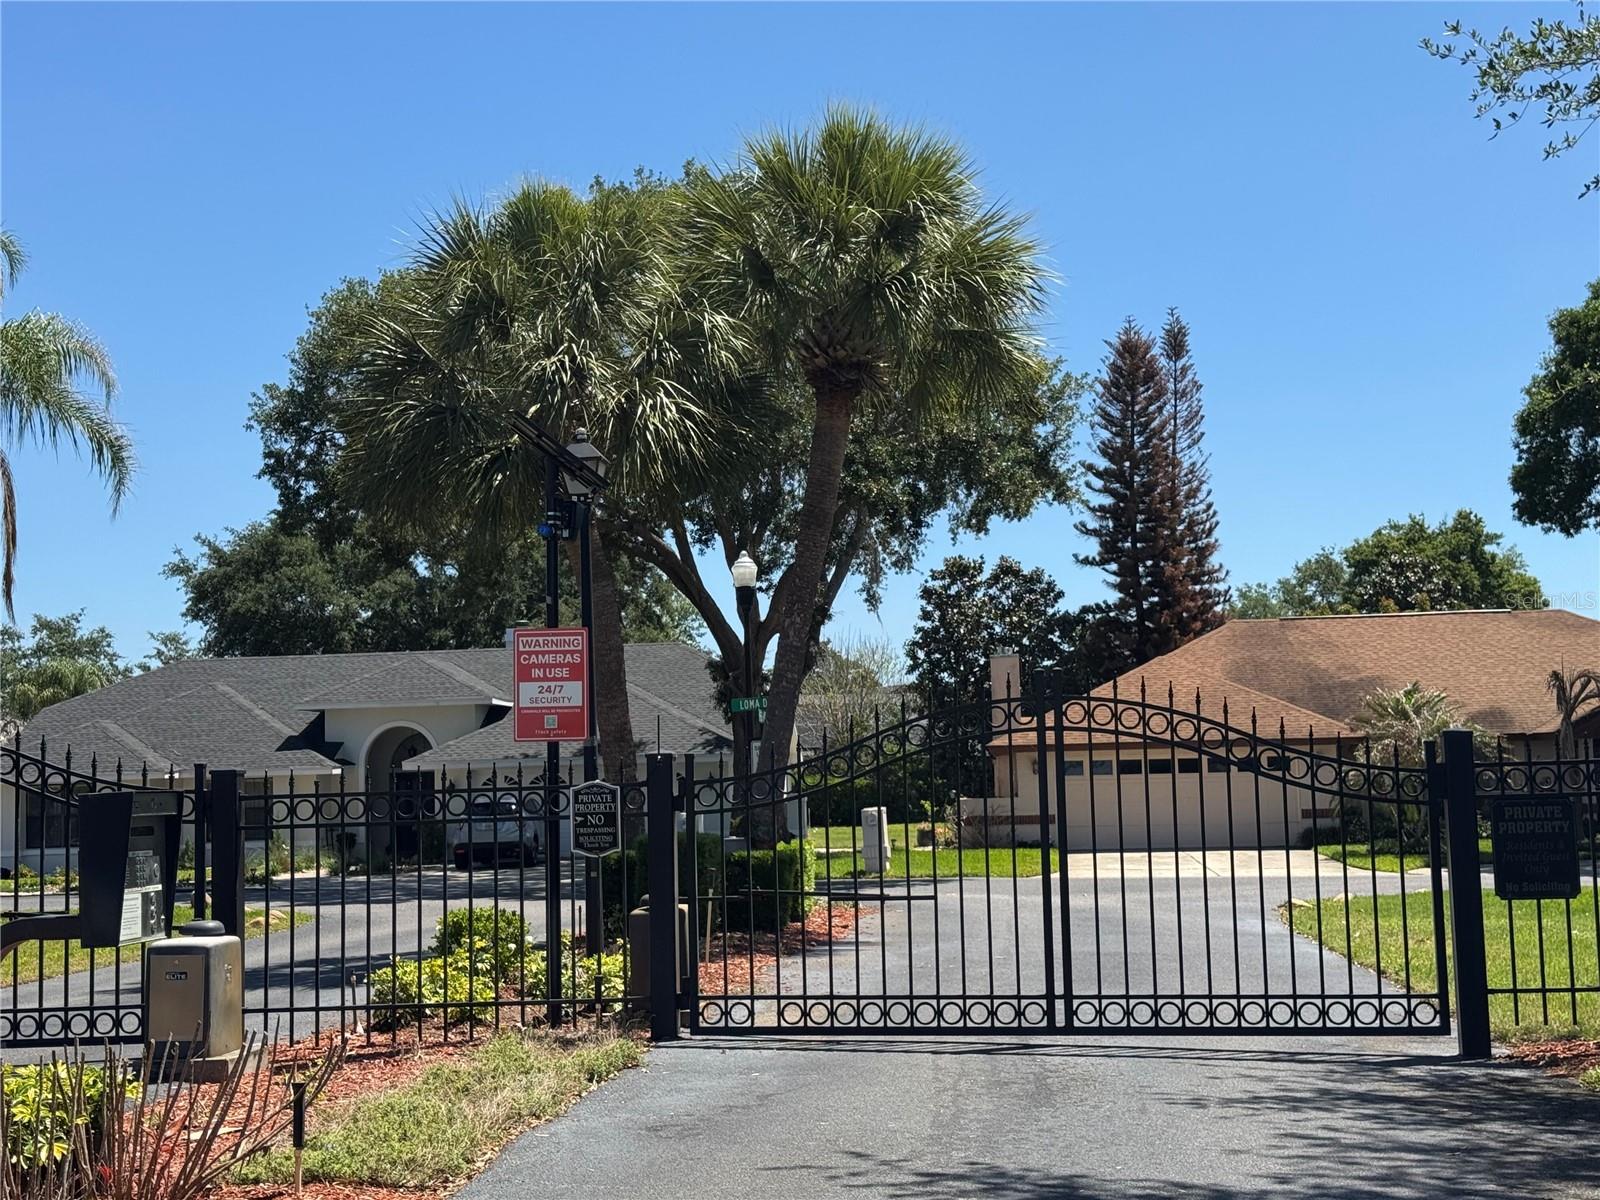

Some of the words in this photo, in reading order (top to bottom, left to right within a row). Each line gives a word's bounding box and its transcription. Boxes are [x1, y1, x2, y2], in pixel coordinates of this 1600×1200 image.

[521, 638, 581, 649] WARNING
[520, 653, 581, 665] CAMERAS
[531, 668, 544, 679] IN
[546, 667, 570, 678] USE
[537, 684, 565, 696] 24/7
[529, 696, 572, 705] SECURITY
[739, 698, 760, 710] LOMA
[578, 794, 613, 803] PRIVATE
[575, 803, 616, 812] PROPERTY
[1503, 806, 1563, 819] PRIVATE
[587, 814, 605, 826] NO
[576, 826, 616, 834] TRESPASSING
[1497, 820, 1570, 834] PROPERTY
[579, 834, 613, 843] SOLICITING
[1505, 882, 1520, 892] No
[1522, 880, 1571, 893] Soliciting
